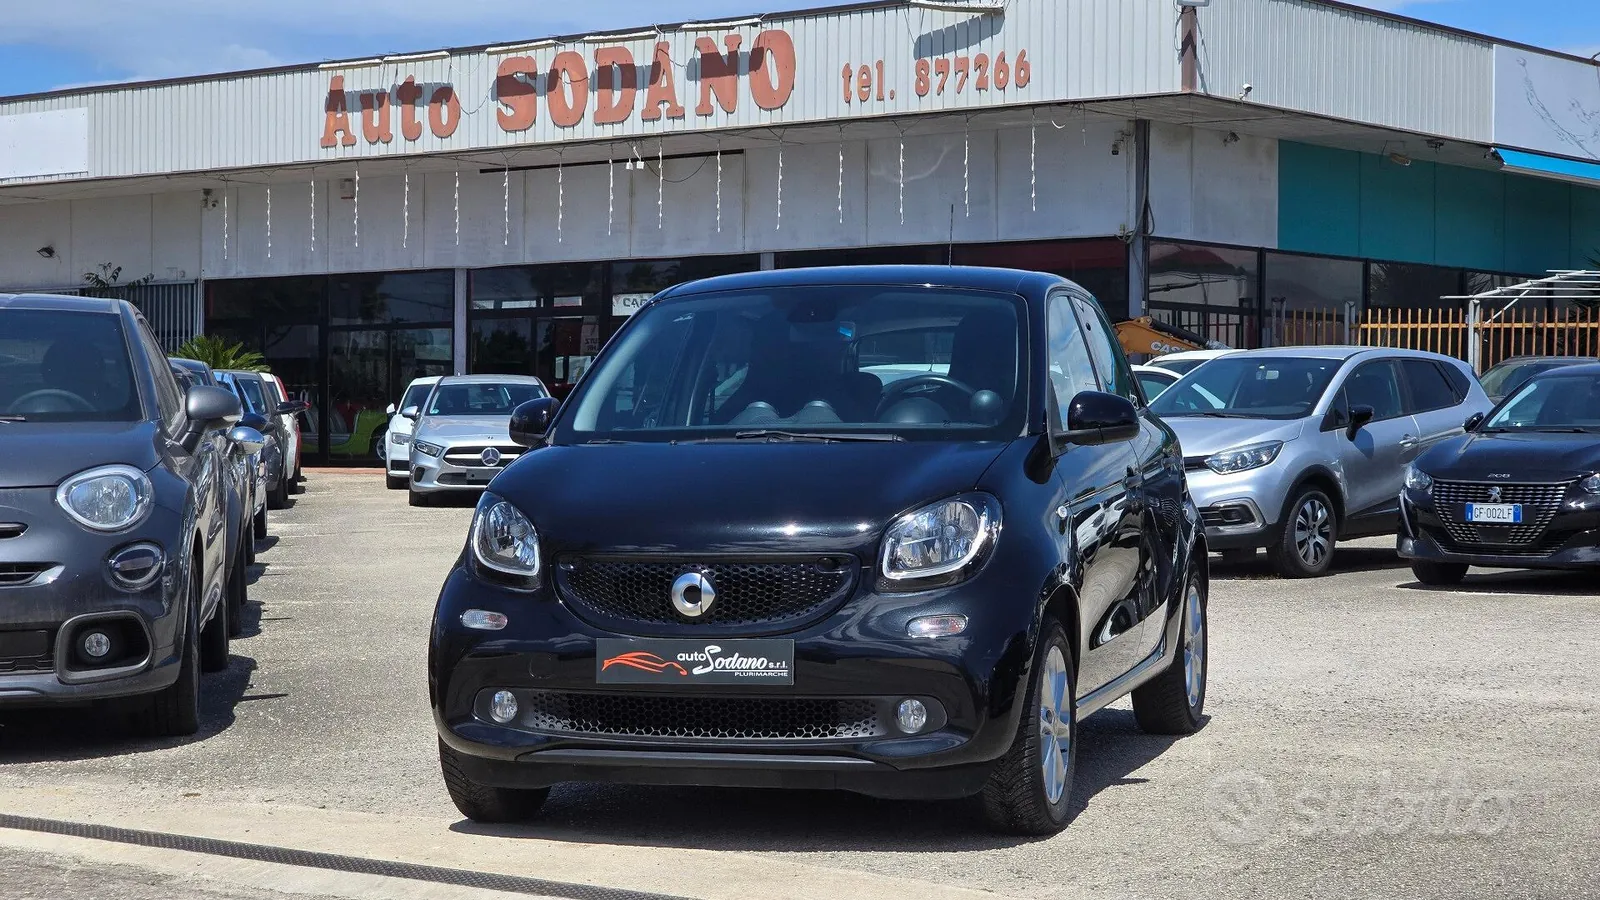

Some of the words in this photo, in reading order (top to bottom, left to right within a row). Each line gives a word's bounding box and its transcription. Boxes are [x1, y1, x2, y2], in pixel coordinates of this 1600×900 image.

[320, 75, 461, 148] Auto
[496, 29, 797, 132] SODANO
[842, 59, 895, 104] tel.
[914, 49, 1030, 97] 877266
